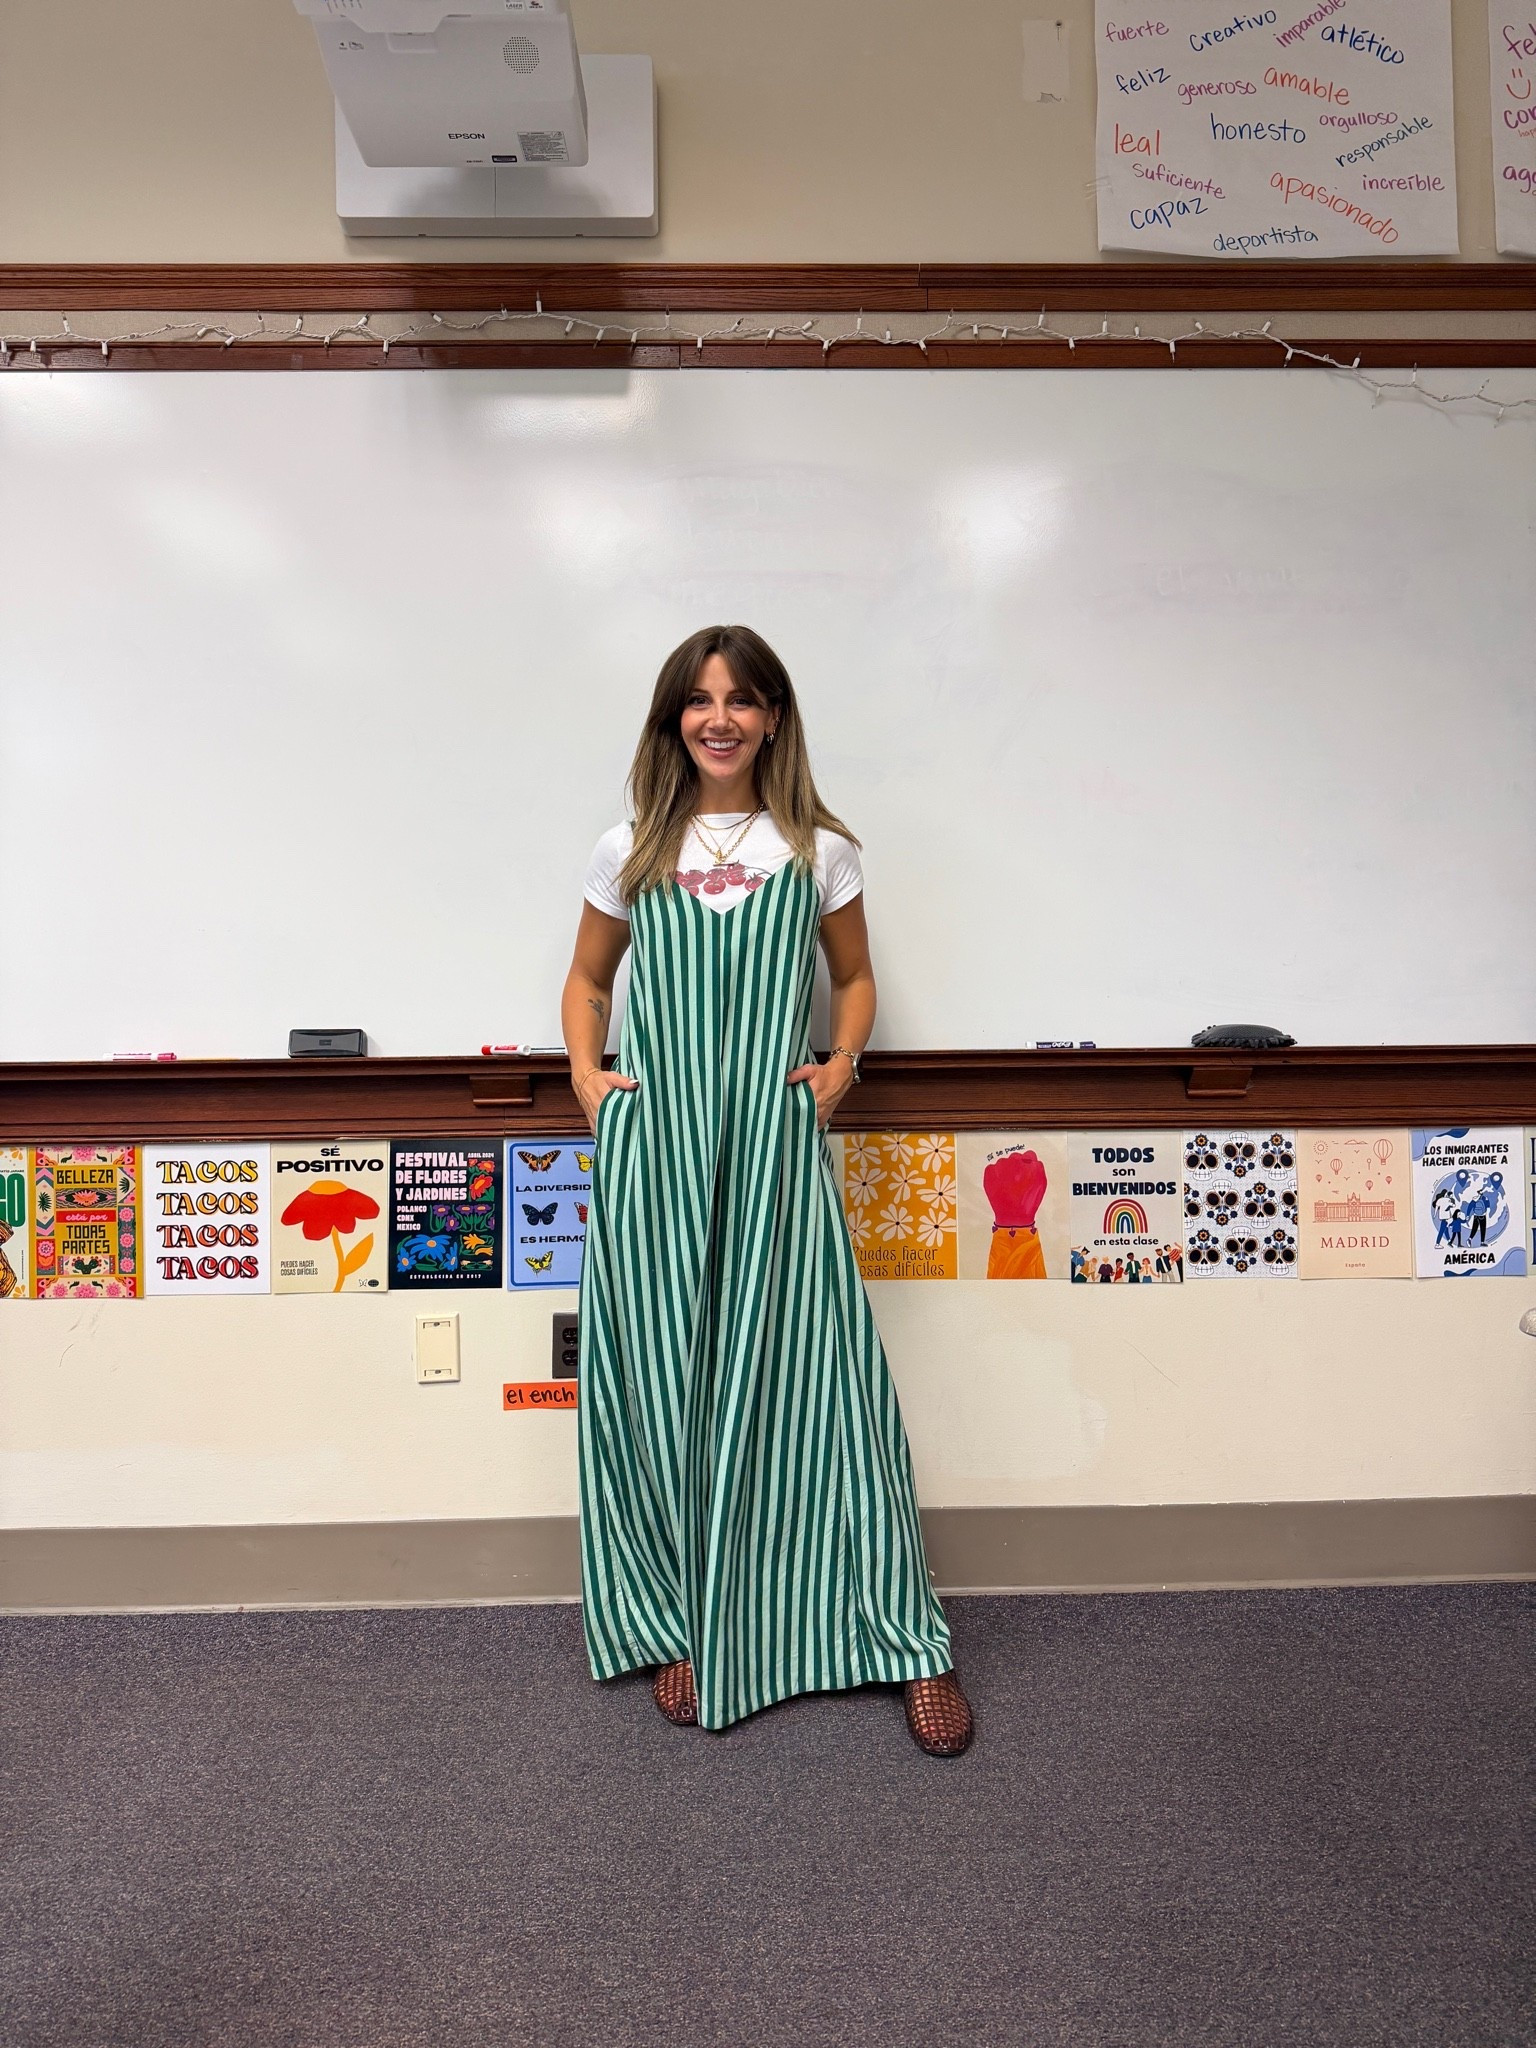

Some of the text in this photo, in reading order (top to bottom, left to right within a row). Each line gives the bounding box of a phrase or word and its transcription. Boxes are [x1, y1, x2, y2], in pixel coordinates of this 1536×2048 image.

[1105, 19, 1169, 43] fuerte
[1273, 0, 1346, 47] imparable
[1321, 24, 1404, 65] atlético
[1115, 66, 1171, 96] feliz
[1264, 66, 1350, 106] amable
[1177, 78, 1257, 105] generoso
[1210, 113, 1306, 144] honesto
[1319, 110, 1398, 134] orgulloso
[448, 132, 485, 140] EPSON
[1114, 124, 1160, 156] leal
[1335, 114, 1433, 169] responsable
[1362, 173, 1445, 192] increíble
[1270, 171, 1399, 245] apasionado
[1213, 225, 1319, 255] deportista
[320, 1145, 340, 1157] SÉ
[1092, 1147, 1155, 1164] TODOS
[1424, 1143, 1509, 1156] LOS INMIGRANTES
[277, 1159, 384, 1173] POSITIVO
[395, 1152, 467, 1168] FESTIVAL
[1422, 1154, 1508, 1166] HACEN GRANDE A
[57, 1169, 113, 1184] BELLEZA
[156, 1160, 259, 1185] TACOS
[395, 1170, 467, 1184] DE FLORES
[1112, 1166, 1136, 1177] son
[395, 1188, 467, 1201] Y JARDINES
[1072, 1181, 1177, 1197] BIENVENIDOS
[156, 1192, 259, 1217] TACOS
[65, 1212, 108, 1223] está por
[66, 1225, 106, 1239] TODAS
[156, 1223, 259, 1248] TACOS
[62, 1240, 110, 1254] PARTES
[1093, 1236, 1159, 1246] en esta clase
[1320, 1235, 1390, 1249] MADRID
[902, 1246, 938, 1260] hacer
[1443, 1250, 1496, 1266] AMÉRICA
[156, 1255, 259, 1280] TACOS
[280, 1260, 298, 1268] PUEDES
[506, 1386, 575, 1404] el ench
